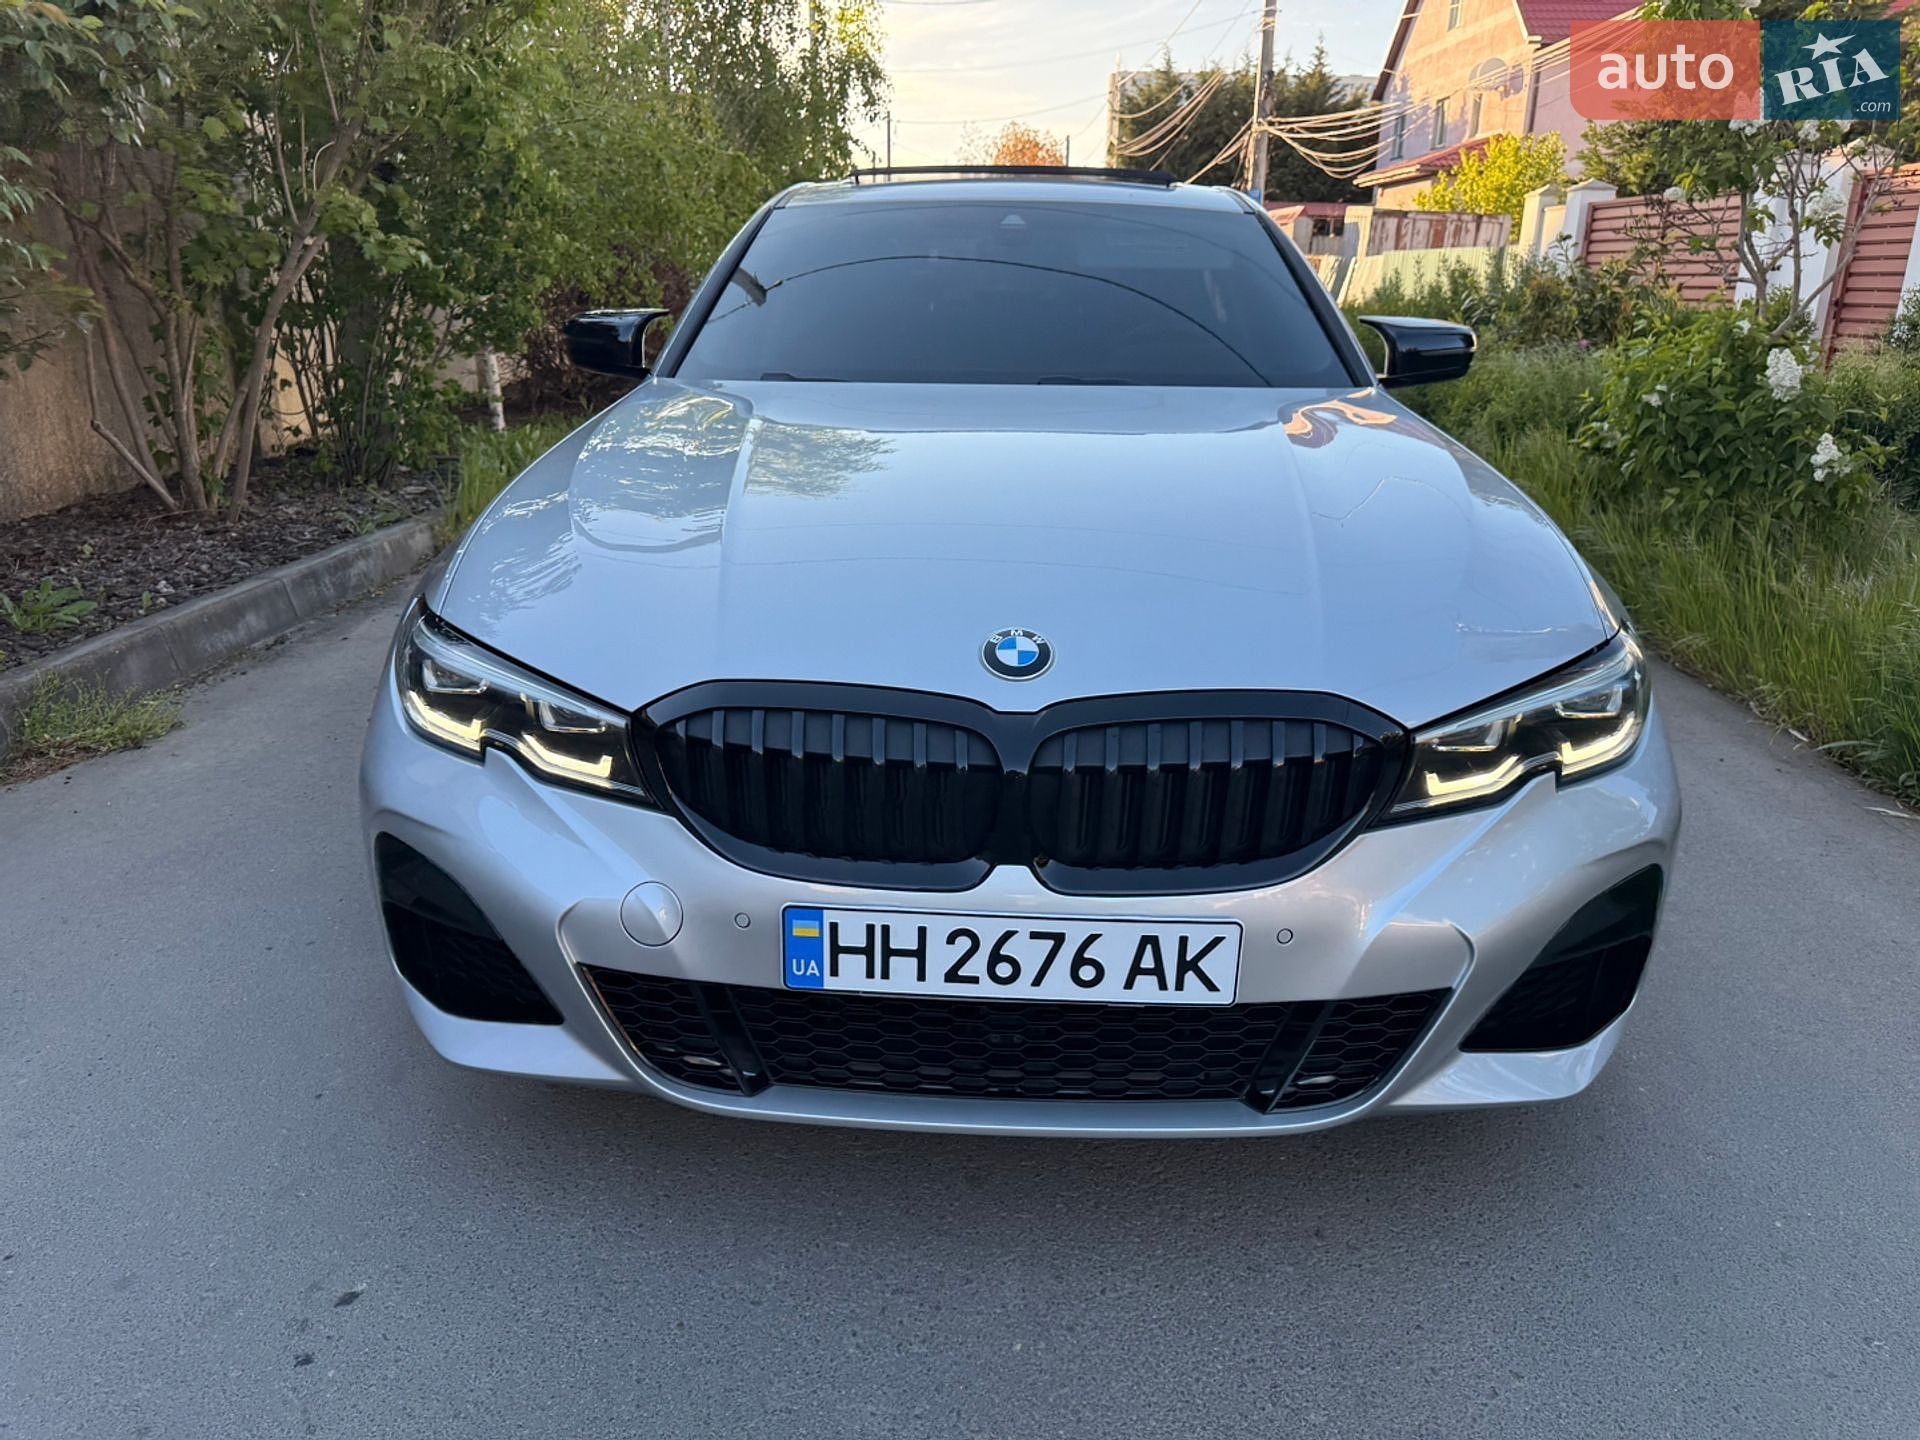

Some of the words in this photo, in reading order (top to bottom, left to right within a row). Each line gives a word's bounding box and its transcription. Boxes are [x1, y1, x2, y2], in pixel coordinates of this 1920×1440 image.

[989, 628, 1045, 644] BMW
[829, 922, 927, 982] HH
[943, 928, 1105, 988] 2676
[1123, 934, 1227, 992] AK
[792, 959, 820, 977] UA
